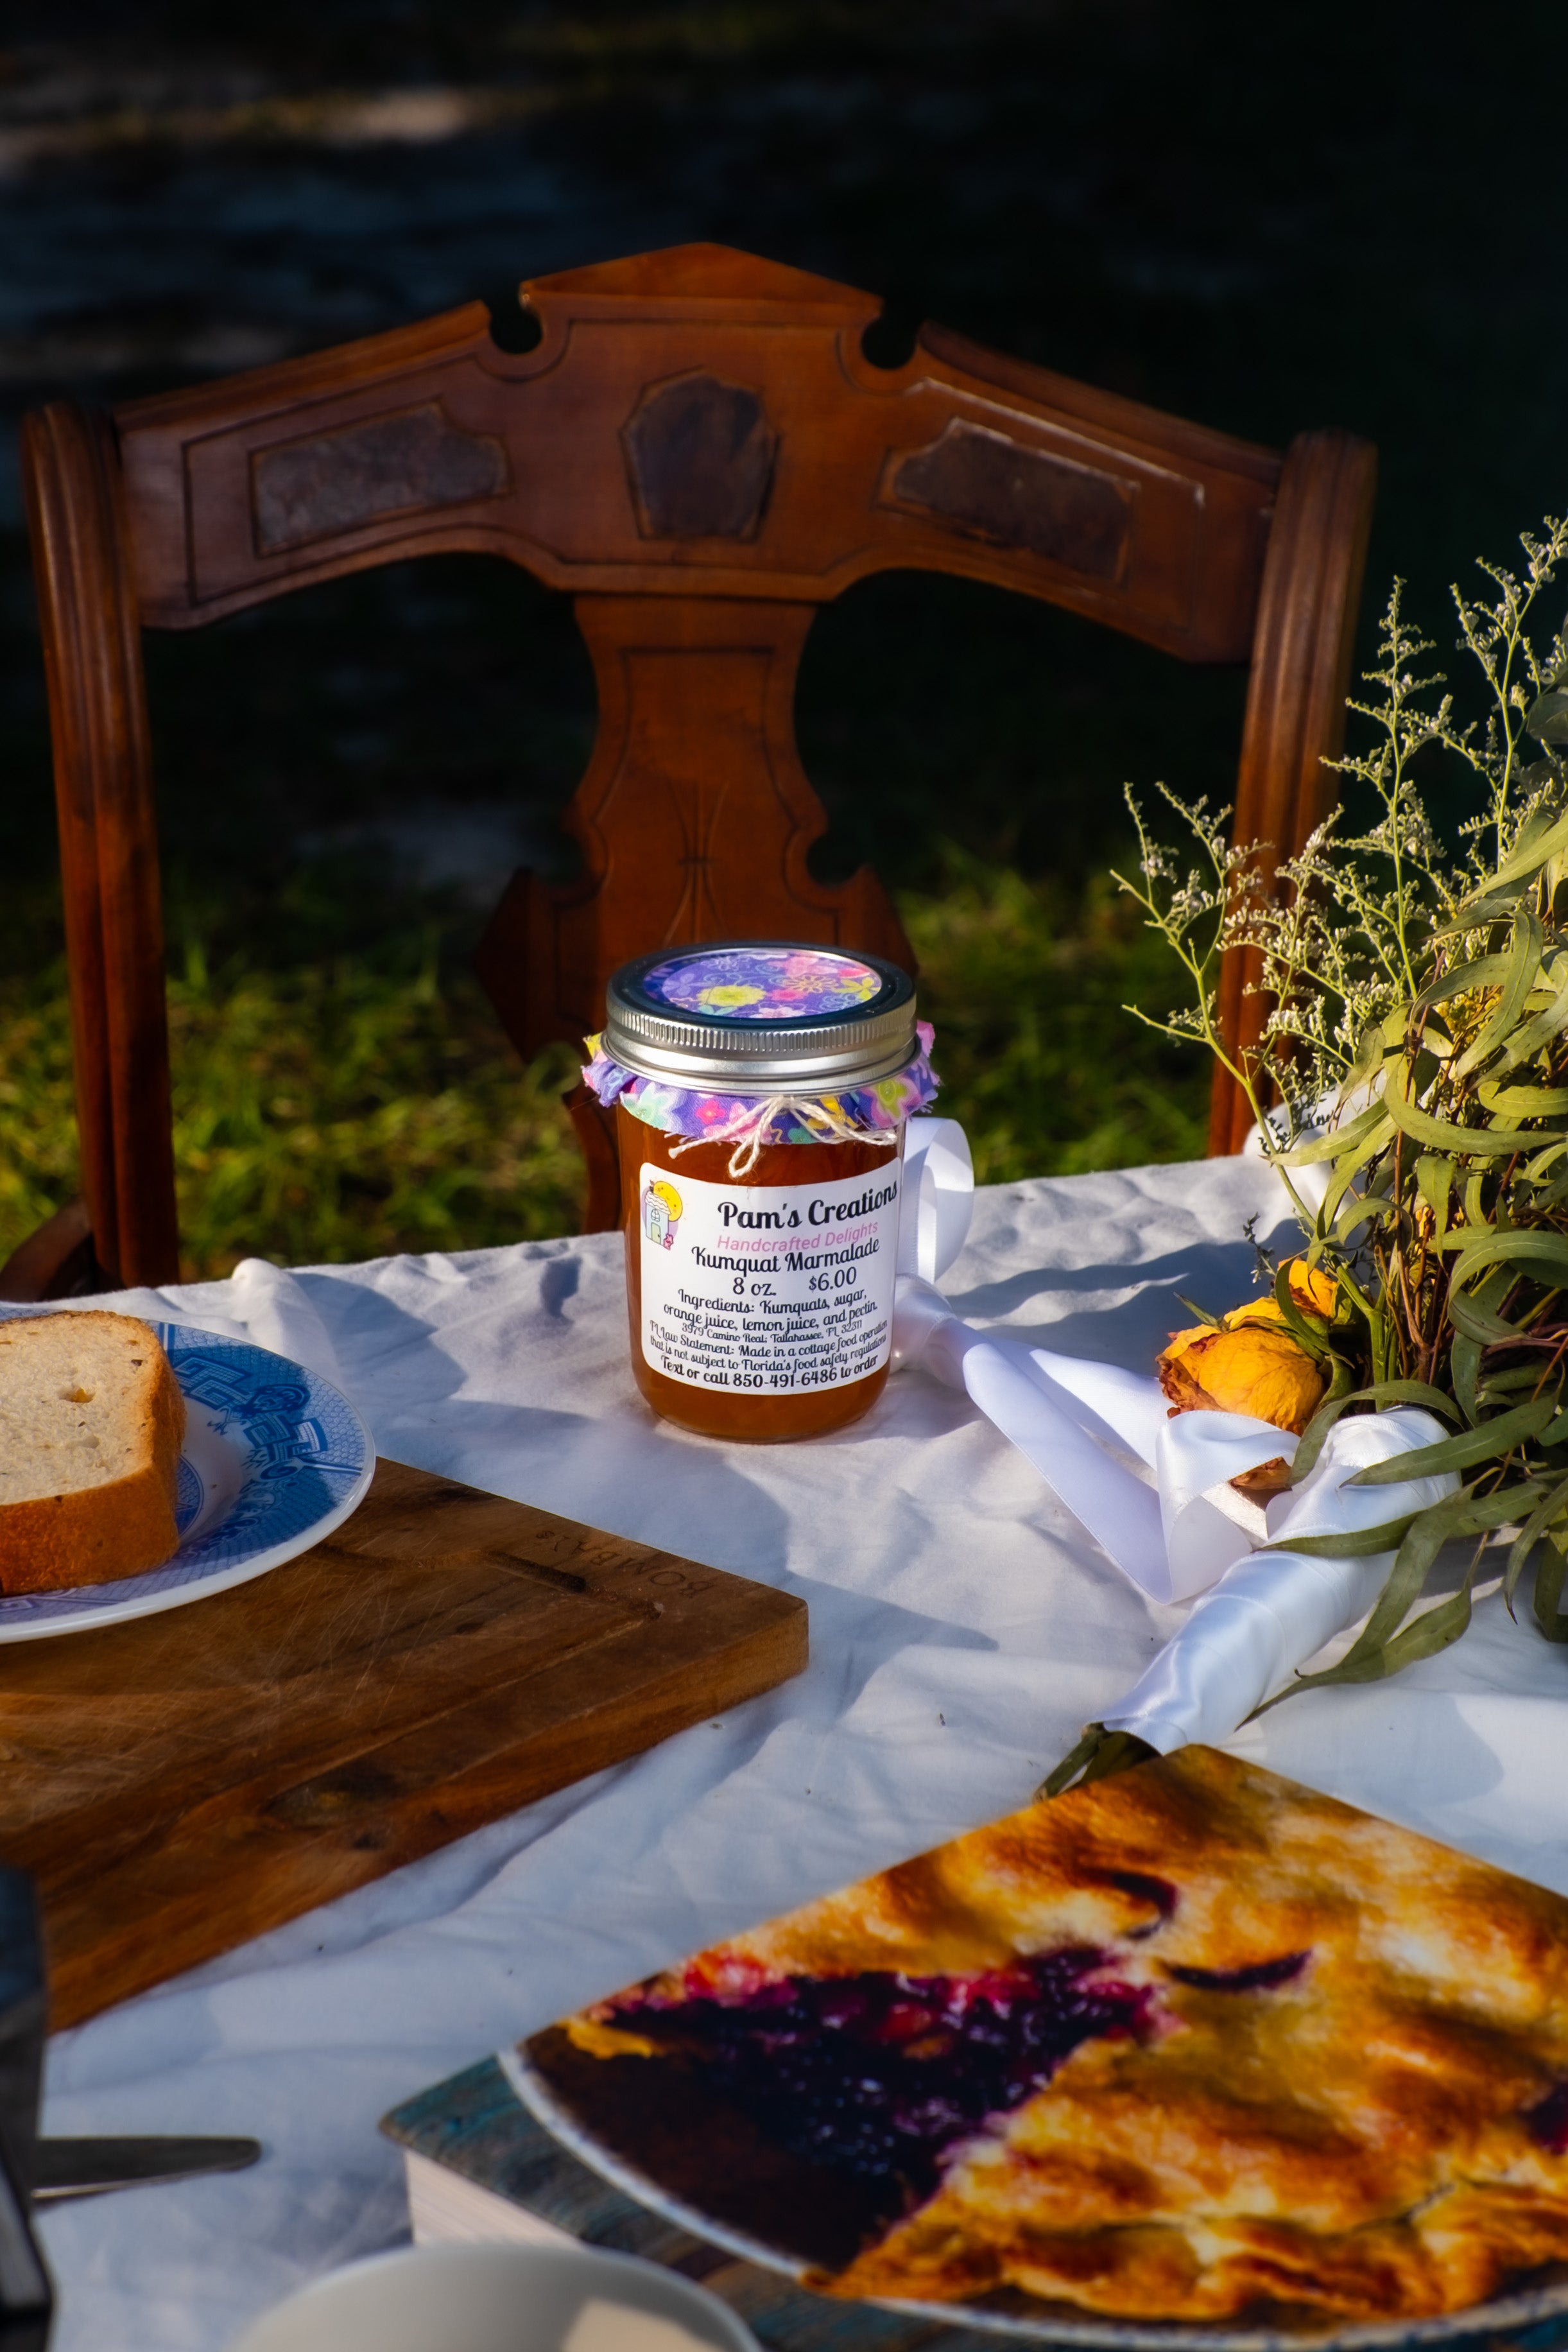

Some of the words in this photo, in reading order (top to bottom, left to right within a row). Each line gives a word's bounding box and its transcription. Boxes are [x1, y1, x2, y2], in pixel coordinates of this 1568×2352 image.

[718, 1202, 802, 1229] Pam's
[808, 1180, 898, 1226] Creations
[717, 1233, 821, 1252] Handcrafted
[824, 1222, 878, 1246] Delights
[691, 1246, 781, 1277] Kumquat
[784, 1237, 880, 1272] Marmalade
[733, 1277, 745, 1295] 8
[751, 1283, 777, 1295] oz.
[809, 1267, 857, 1293] $6.00
[664, 1304, 702, 1326] orange
[703, 1313, 738, 1331] juice,
[743, 1318, 784, 1331] lemon
[784, 1317, 819, 1334] juice,
[823, 1309, 847, 1326] and
[849, 1301, 878, 1324] pectin.
[678, 1288, 754, 1313] Ingredients:
[759, 1297, 830, 1317] Kumquats,
[834, 1289, 866, 1307] sugar,
[650, 1320, 662, 1338] FL
[661, 1327, 678, 1342] Law
[680, 1335, 734, 1354] Statement:
[738, 1345, 771, 1357] Made
[774, 1346, 785, 1357] in
[788, 1348, 796, 1356] a
[798, 1342, 836, 1354] cottage
[836, 1334, 857, 1352] food
[859, 1320, 888, 1344] operation
[682, 1322, 704, 1336] 3979
[707, 1328, 741, 1342] Camino
[826, 1327, 840, 1337] FL
[841, 1319, 862, 1334] 32311
[650, 1335, 664, 1351] that
[665, 1342, 672, 1354] is
[674, 1347, 689, 1361] not
[691, 1354, 726, 1369] subject
[728, 1359, 739, 1369] to
[741, 1359, 791, 1371] Florida's
[793, 1357, 818, 1374] food
[820, 1352, 849, 1368] safety
[850, 1334, 886, 1359] regulations
[660, 1354, 685, 1376] Text
[687, 1368, 700, 1379] or
[703, 1372, 730, 1385] call
[733, 1367, 837, 1388] 850-491-6486
[841, 1366, 852, 1378] to
[854, 1355, 878, 1374] order
